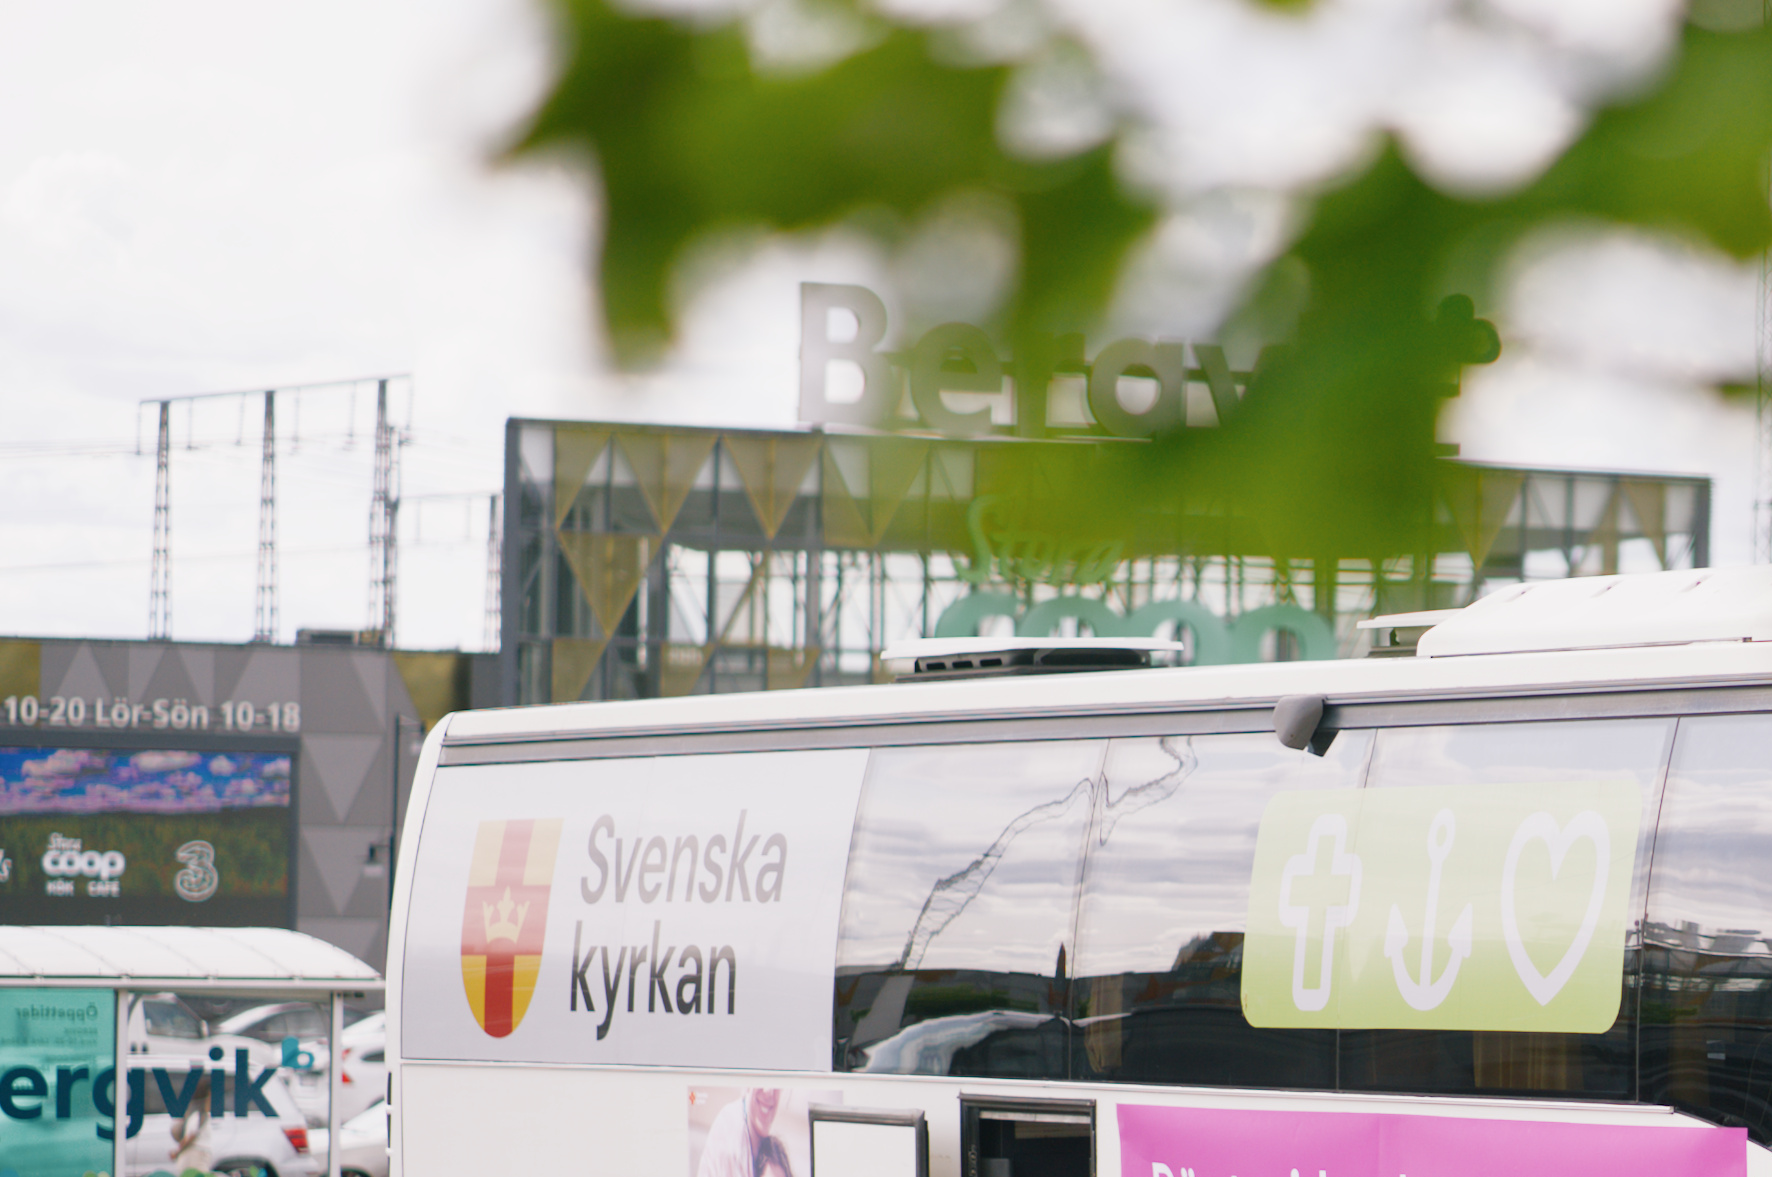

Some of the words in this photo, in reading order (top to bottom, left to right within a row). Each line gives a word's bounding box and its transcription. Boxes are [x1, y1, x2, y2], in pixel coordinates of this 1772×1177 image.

[798, 282, 1300, 442] Bergv
[4, 695, 86, 726] 10-20
[96, 697, 209, 729] Lör-Sön
[221, 701, 300, 732] 10-18
[41, 850, 126, 881] coop
[581, 808, 788, 905] Svenska
[569, 919, 737, 1041] kyrkan
